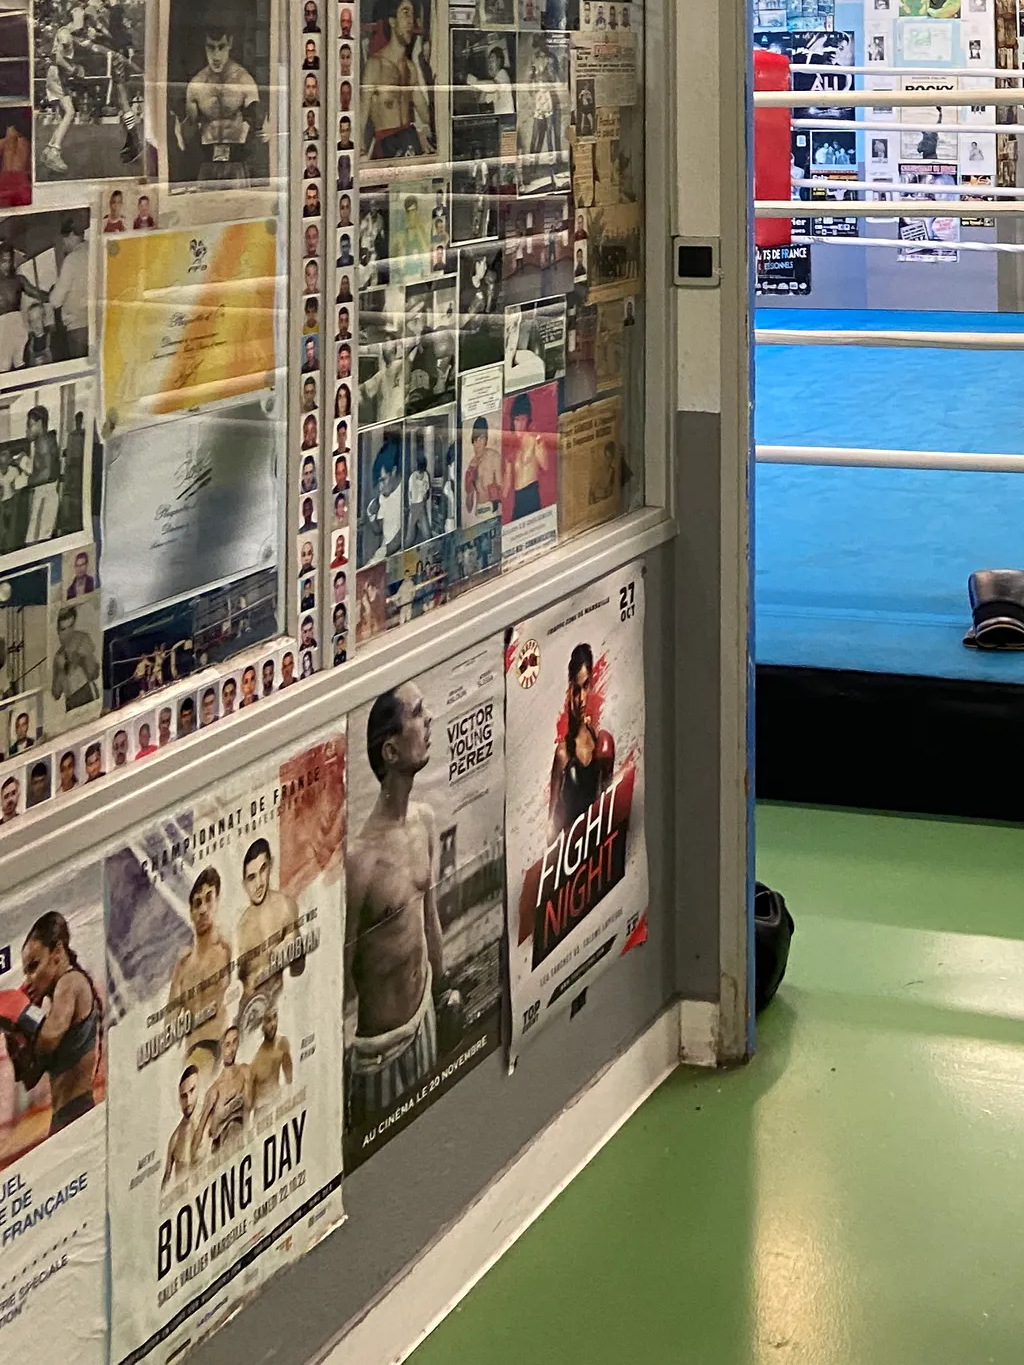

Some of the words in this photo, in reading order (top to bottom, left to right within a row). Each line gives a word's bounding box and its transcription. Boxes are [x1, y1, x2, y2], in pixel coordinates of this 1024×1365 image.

[811, 74, 839, 91] ALI
[772, 249, 781, 259] DE
[781, 248, 807, 259] FRANCE
[620, 581, 635, 610] 27
[620, 604, 635, 622] OCT
[447, 703, 493, 744] VICTOR
[448, 723, 493, 762] YOUNG
[142, 808, 242, 877] CHAMPIONNAT
[251, 795, 265, 818] DE
[273, 766, 320, 805] FRANCE
[536, 775, 624, 908] FIGHT
[543, 830, 619, 948] NIGHT
[522, 999, 541, 1024] TOP
[362, 1128, 376, 1148] AU
[416, 1086, 428, 1103] LE
[429, 1076, 440, 1092] 20
[441, 1034, 488, 1081] NOVEMBRE
[2, 1171, 88, 1247] FRANÇAISE
[11, 1188, 33, 1218] DE
[157, 1154, 253, 1282] BOXING
[263, 1110, 307, 1191] DAY
[157, 1280, 179, 1308] SALLE
[180, 1253, 209, 1289] VALLIER
[210, 1218, 247, 1262] MARSEILLE
[253, 1197, 277, 1223] SAMEDI
